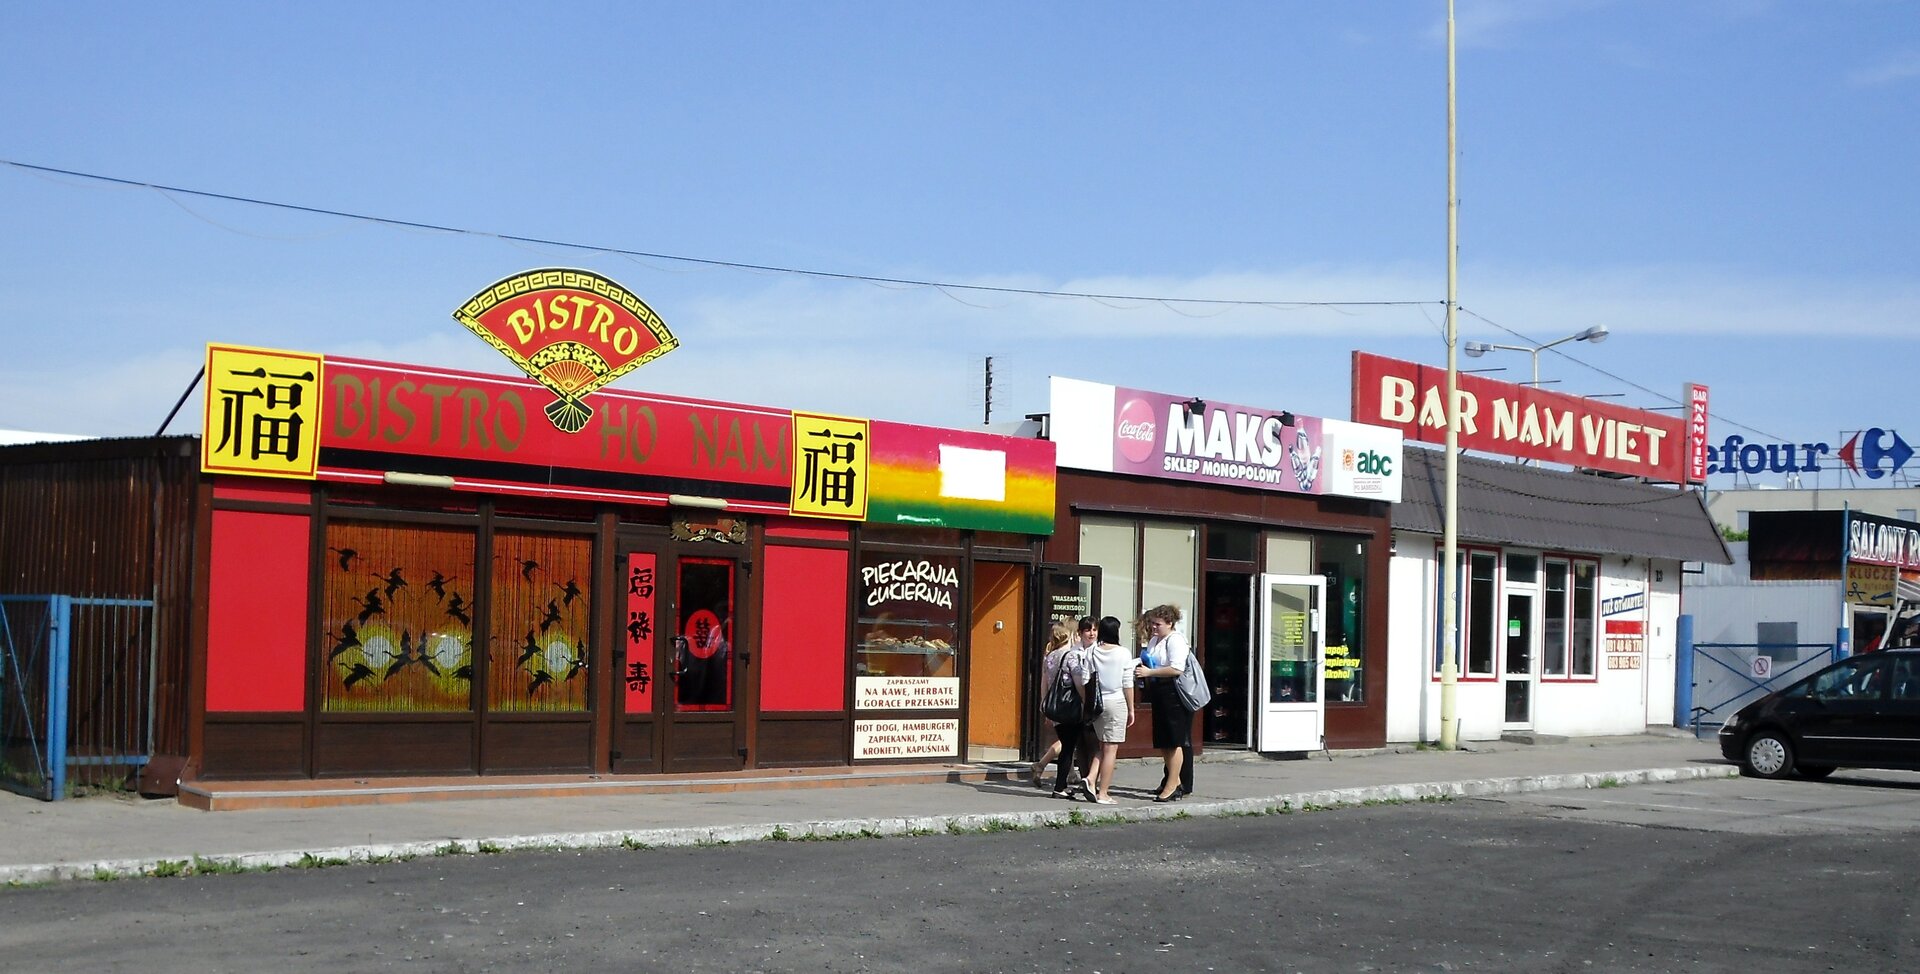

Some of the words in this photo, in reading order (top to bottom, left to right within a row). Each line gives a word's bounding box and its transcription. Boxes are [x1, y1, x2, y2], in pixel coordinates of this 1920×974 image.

[505, 294, 639, 356] BISTRO
[1693, 389, 1707, 402] BAR
[213, 366, 315, 463] 福
[329, 373, 529, 453] BISTRO
[599, 401, 658, 463] HO
[688, 413, 788, 476] NAM
[1380, 374, 1480, 436] BAR
[1492, 397, 1574, 452] NAM
[1580, 413, 1668, 466] VIET
[1693, 403, 1705, 435] NAM
[1163, 401, 1285, 468] MAKS
[799, 428, 864, 508] 福
[1163, 455, 1201, 473] SKLEP
[1201, 460, 1282, 485] MONOPOLOWY
[1357, 449, 1393, 477] abc
[1693, 437, 1704, 476] VIET
[1850, 519, 1907, 565] SALONY
[1908, 529, 1920, 566] R
[861, 560, 959, 588] PIEKARNIA
[1850, 567, 1896, 580] KLUCZE
[867, 582, 953, 609] CUKIERNIA
[856, 699, 860, 707] I
[865, 687, 878, 696] NA
[856, 724, 874, 732] HOT
[876, 723, 900, 732] DOGI,
[902, 722, 957, 731] HAMBURGERY,
[868, 735, 918, 744] ZAPIEKANKI,
[920, 733, 945, 742] PIZZA,
[862, 746, 904, 755] KROKIETY,
[906, 743, 950, 754] KAPUŚNIAK
